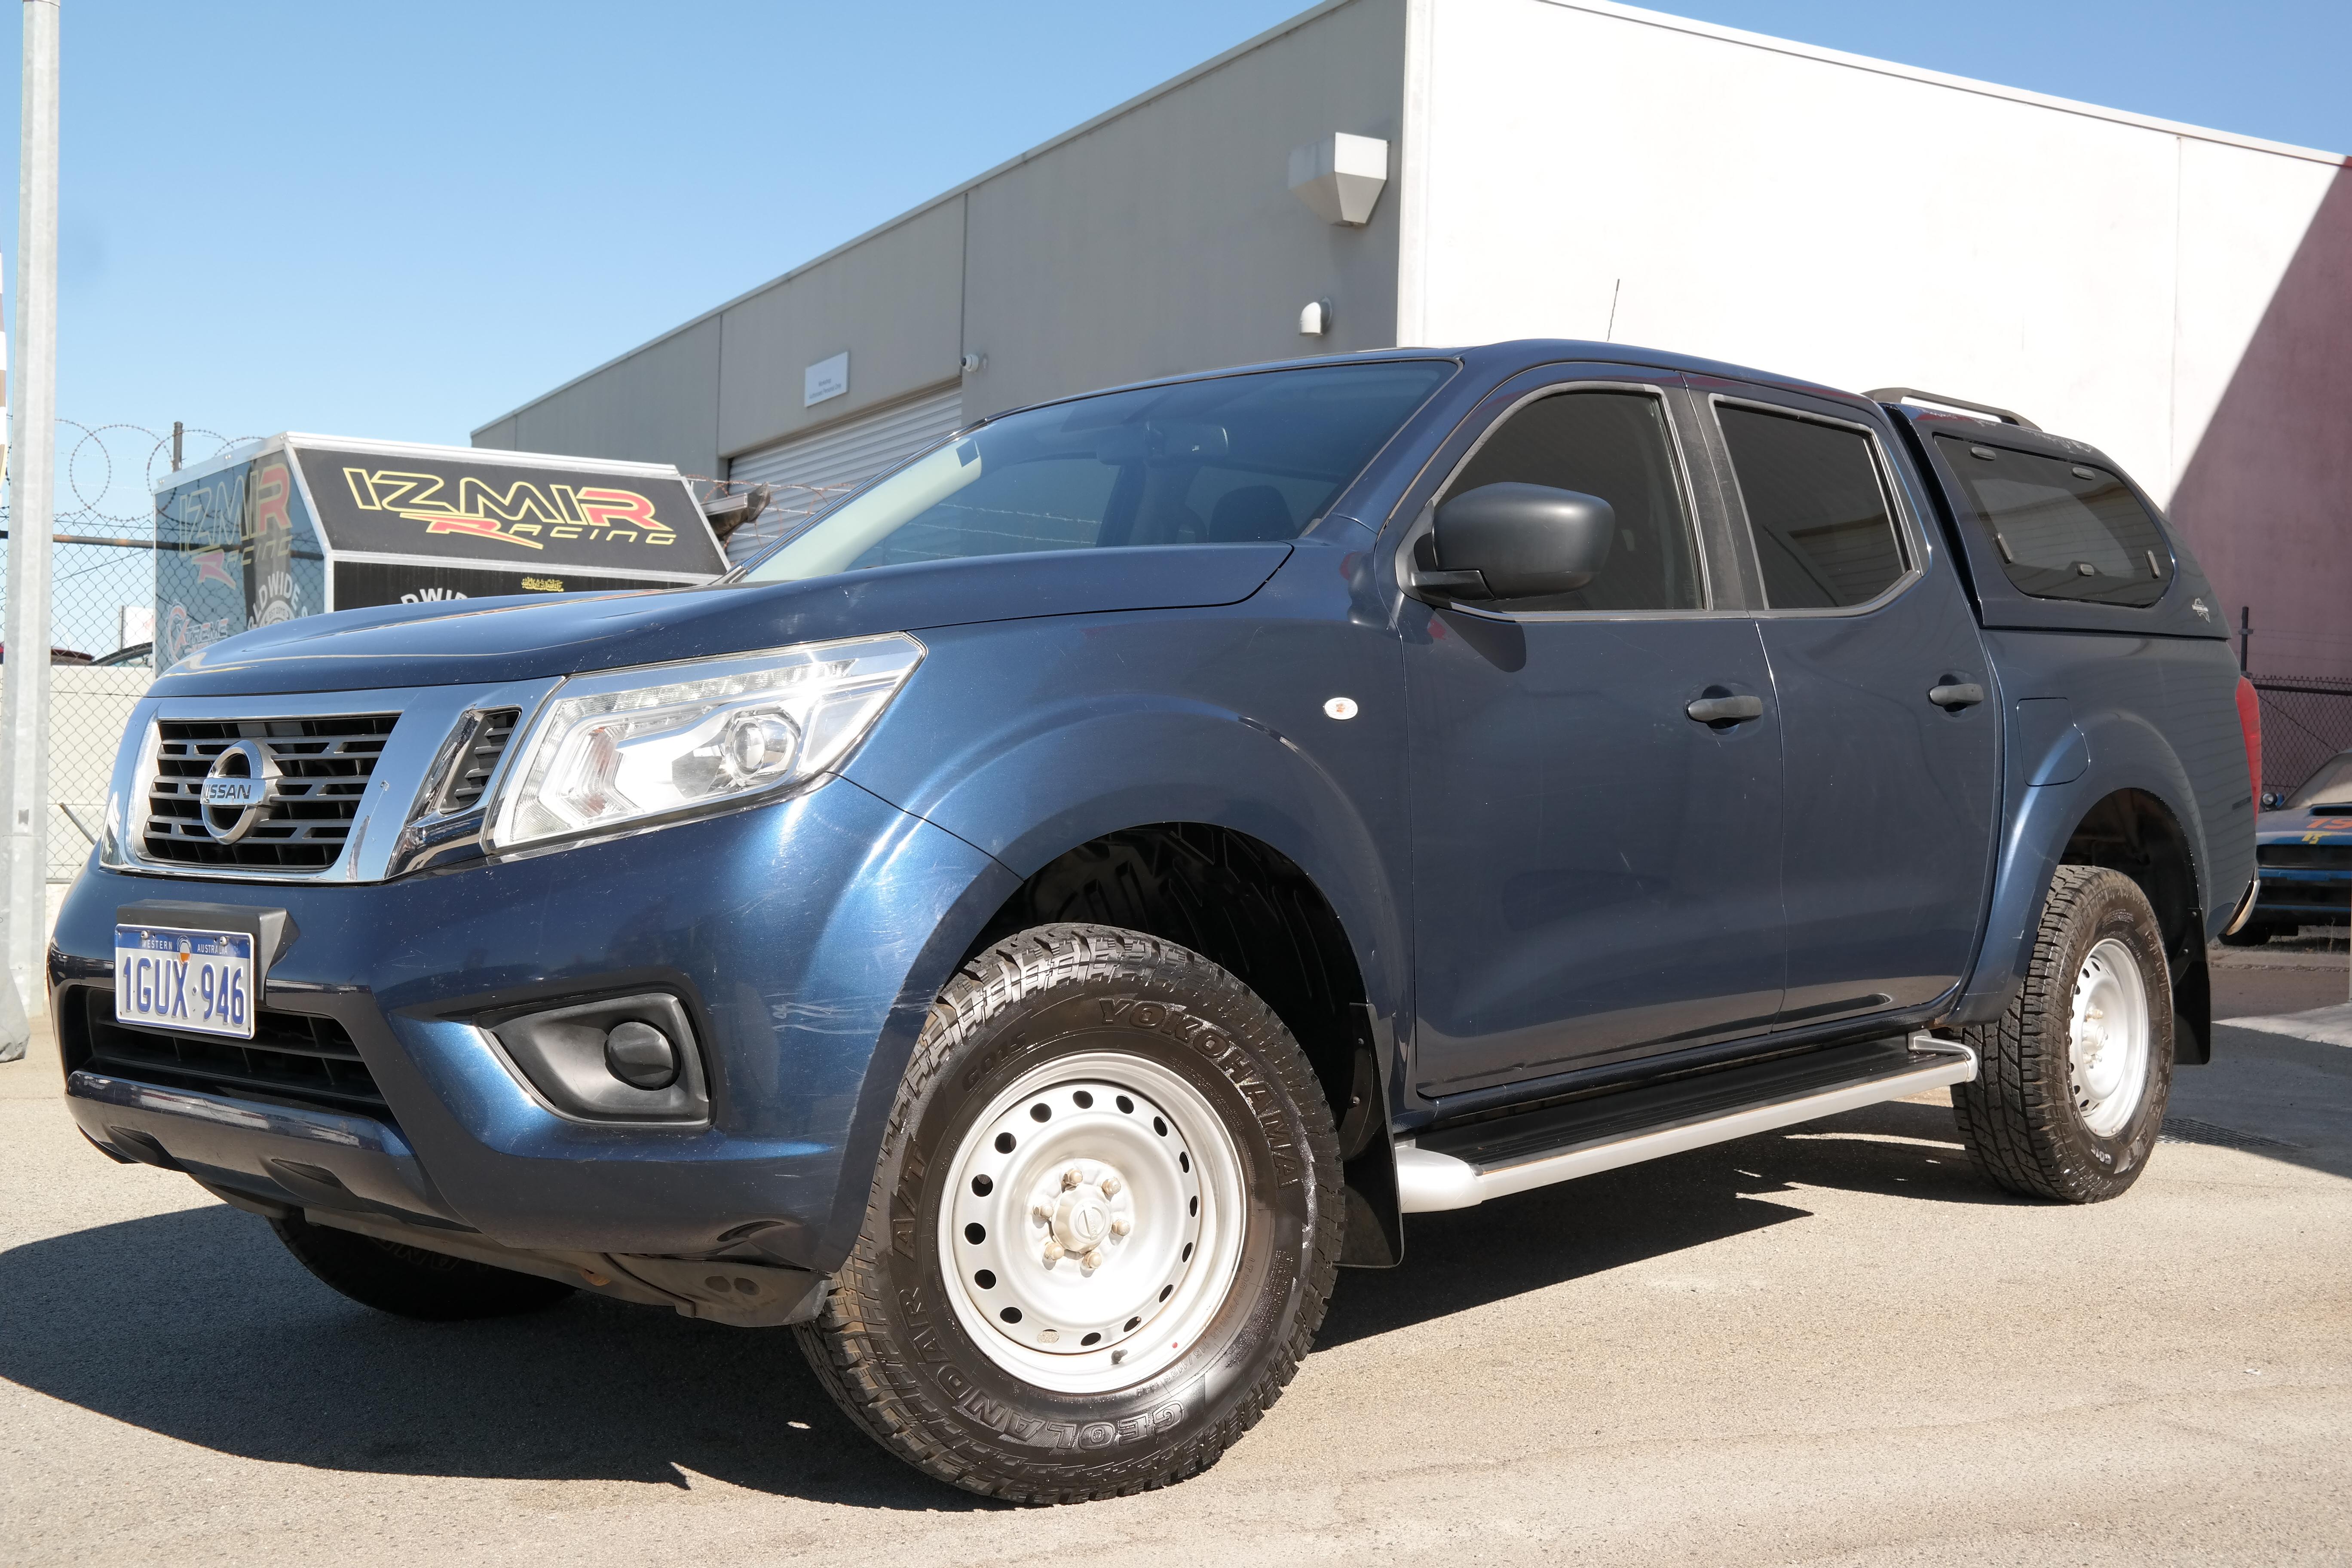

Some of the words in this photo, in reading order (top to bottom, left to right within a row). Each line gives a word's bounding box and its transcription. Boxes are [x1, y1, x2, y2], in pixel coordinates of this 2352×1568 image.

[179, 462, 293, 557] IZMIR
[343, 467, 674, 531] IZMIR
[142, 940, 172, 950] WESTERN
[197, 944, 228, 955] AUSTRALIA
[1099, 998, 1301, 1189] YOKOHAMA
[898, 1287, 1185, 1451] GEOLANDAR
